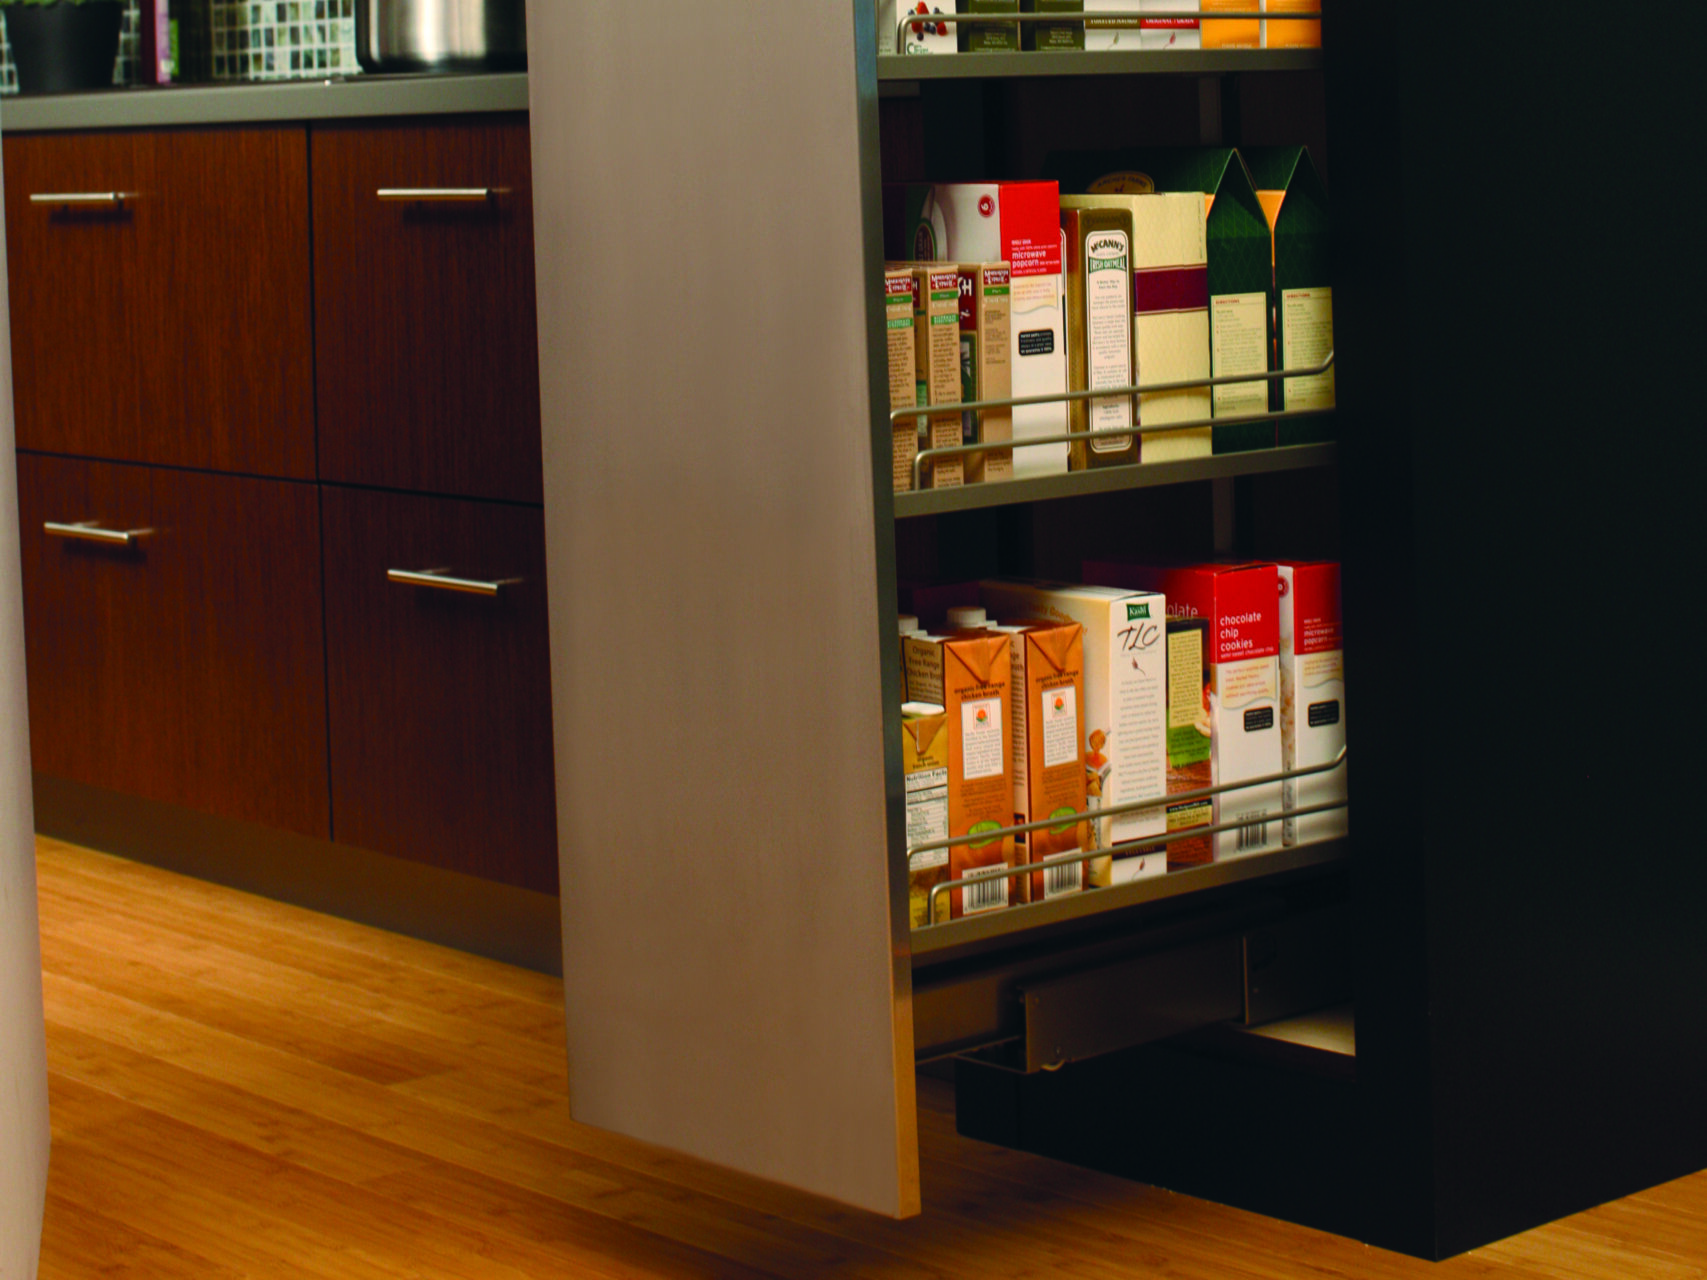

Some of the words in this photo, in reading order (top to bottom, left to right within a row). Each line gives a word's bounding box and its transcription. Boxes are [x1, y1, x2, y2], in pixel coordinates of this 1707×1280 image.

[1011, 249, 1047, 260] microwave
[1012, 259, 1039, 269] popcorn
[1167, 602, 1199, 617] olate
[1220, 611, 1262, 627] chocolate
[1117, 622, 1160, 651] TLC
[1220, 627, 1239, 641] chip
[1220, 638, 1253, 652] cookies
